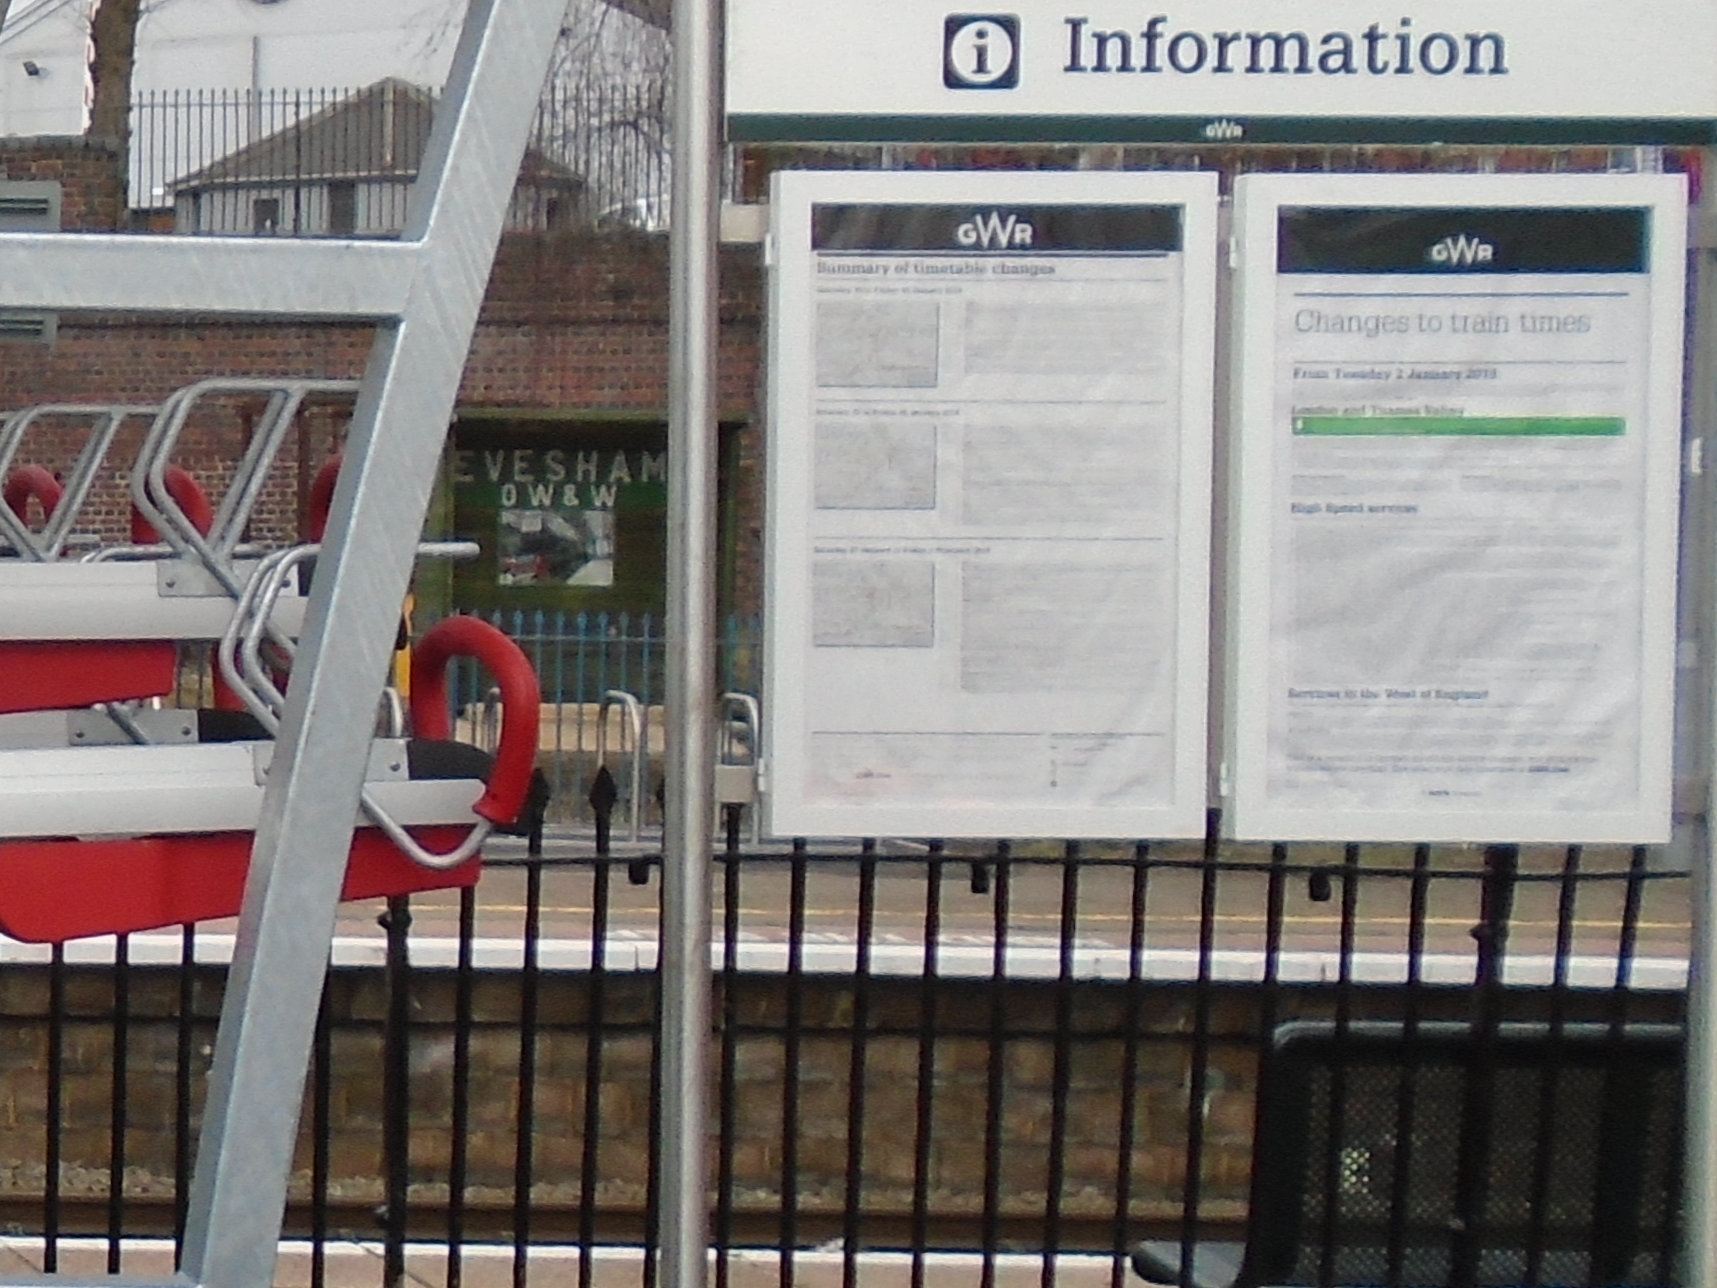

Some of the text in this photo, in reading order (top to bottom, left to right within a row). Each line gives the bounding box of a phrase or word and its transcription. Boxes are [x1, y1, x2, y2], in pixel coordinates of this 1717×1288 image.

[1063, 16, 1508, 75] Information
[1206, 119, 1242, 137] GWR
[957, 212, 1032, 248] GWR
[1432, 235, 1492, 264] GWR
[1295, 310, 1590, 338] Changes to train times
[453, 449, 668, 483] EVESHAM
